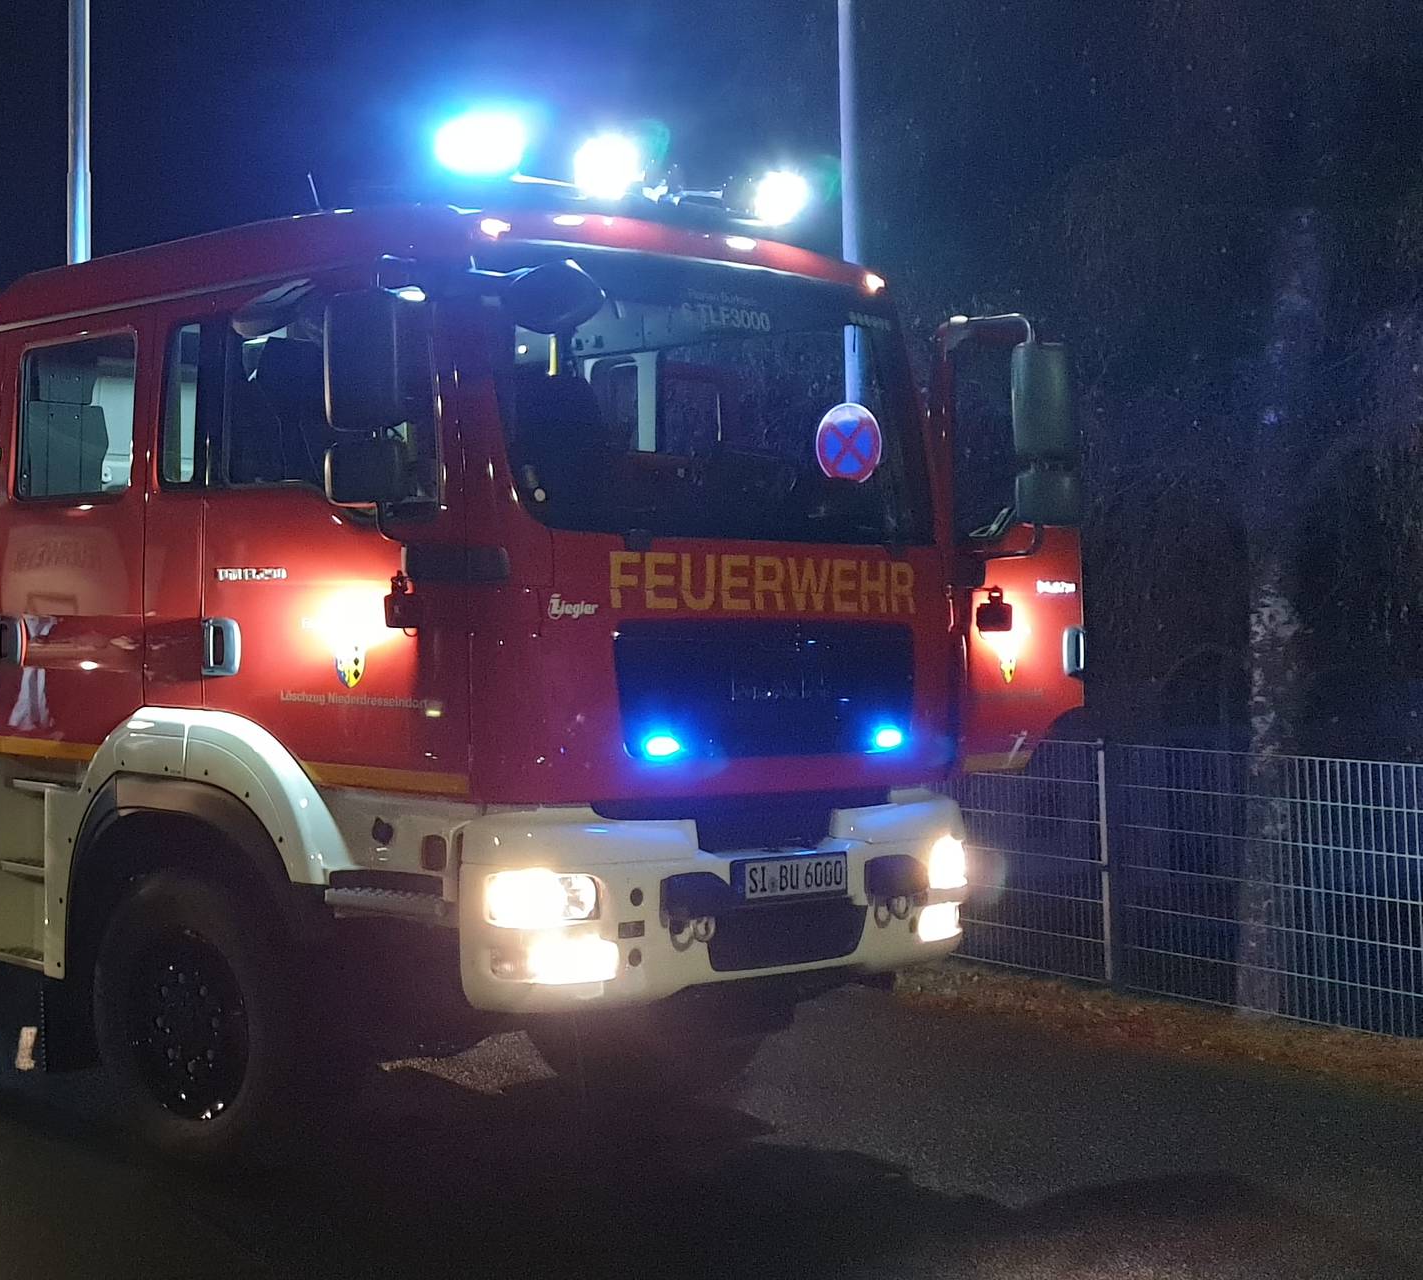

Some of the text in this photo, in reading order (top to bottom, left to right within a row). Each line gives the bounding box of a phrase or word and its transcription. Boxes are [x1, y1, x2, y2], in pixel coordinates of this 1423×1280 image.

[696, 302, 772, 332] TLF3000
[609, 551, 918, 614] FEUERWEHR
[280, 689, 326, 706] Löschzug
[749, 860, 843, 894] SI BU 6000
